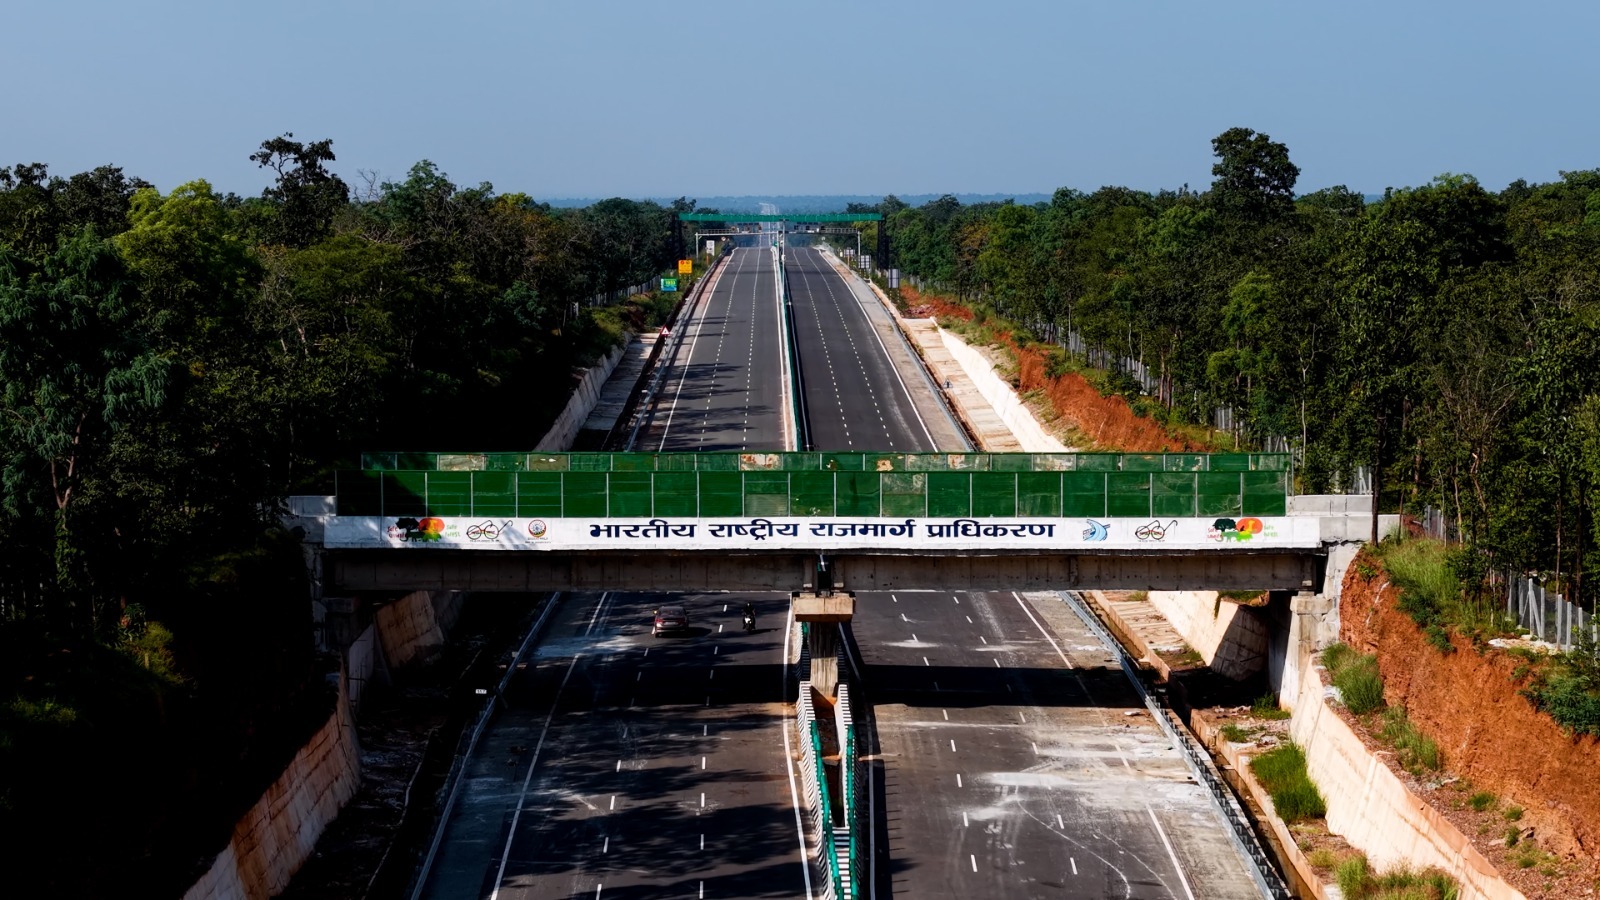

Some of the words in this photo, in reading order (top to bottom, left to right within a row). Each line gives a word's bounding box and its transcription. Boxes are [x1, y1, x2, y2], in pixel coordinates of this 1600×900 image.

[590, 519, 698, 537] भारतीय
[708, 519, 800, 540] राष्ट्रीय
[809, 519, 917, 537] राजमार्ग
[925, 519, 1057, 537] प्राधिकरण
